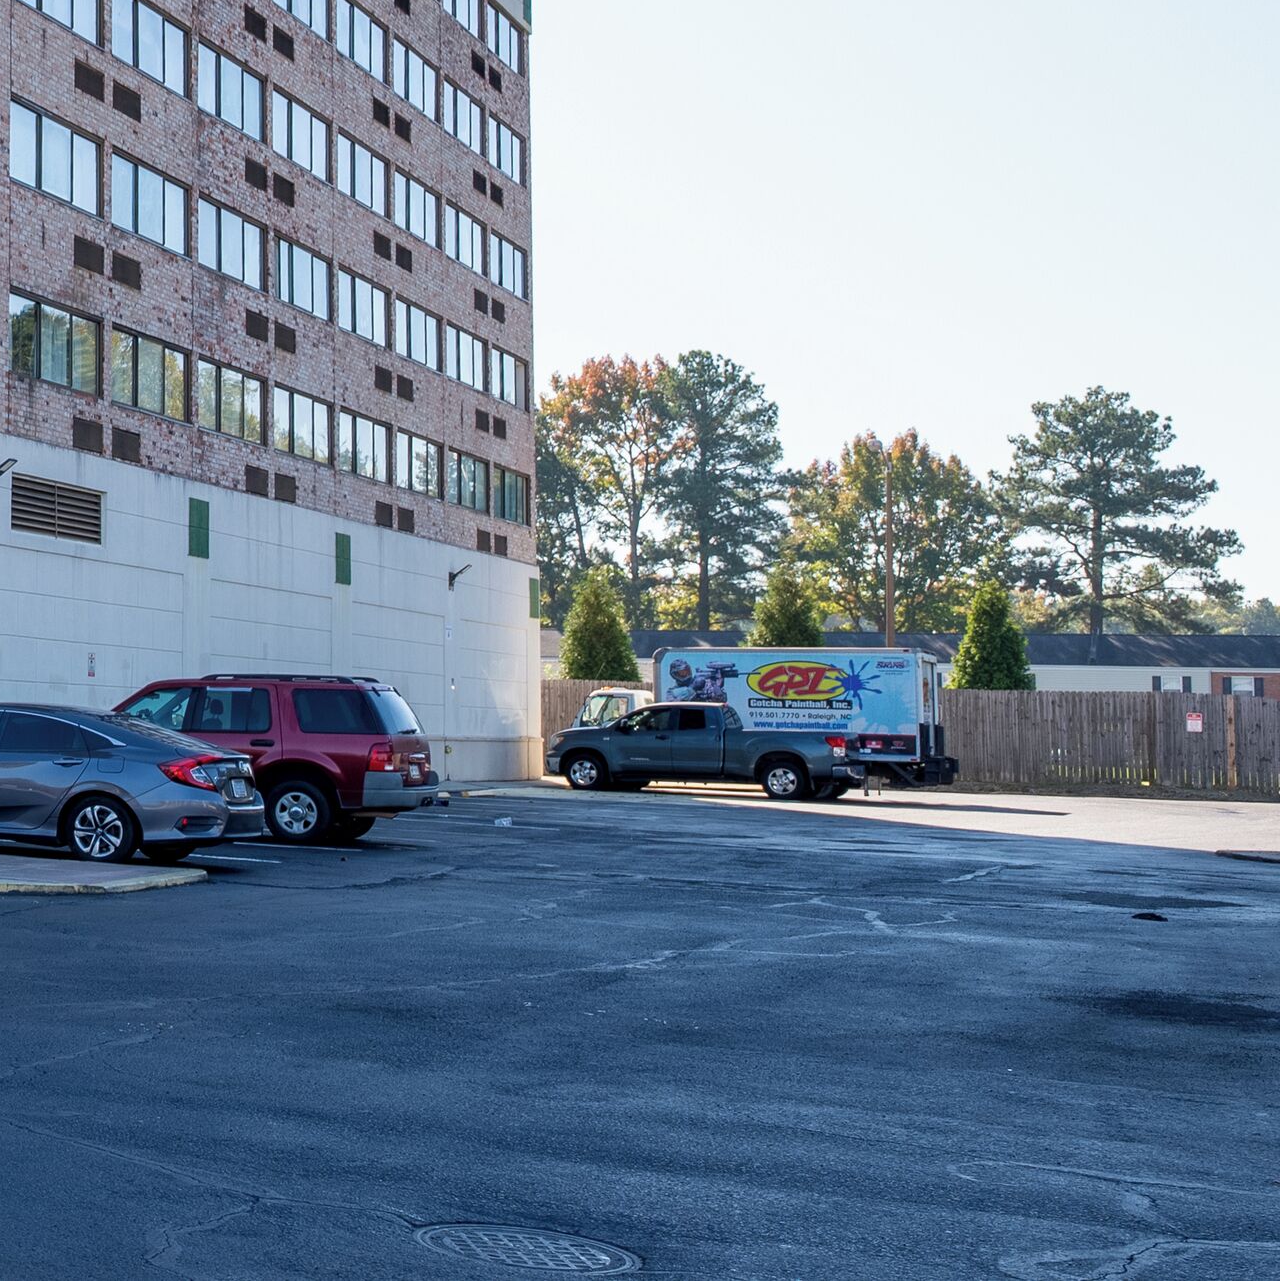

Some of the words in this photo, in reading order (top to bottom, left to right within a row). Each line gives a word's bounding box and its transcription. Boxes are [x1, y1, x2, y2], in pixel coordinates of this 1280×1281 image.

[750, 699, 783, 707] Gotcha
[832, 701, 851, 709] Inc.
[749, 711, 800, 719] 919.501.7770
[753, 720, 848, 730] www.gotchapaintball.com
